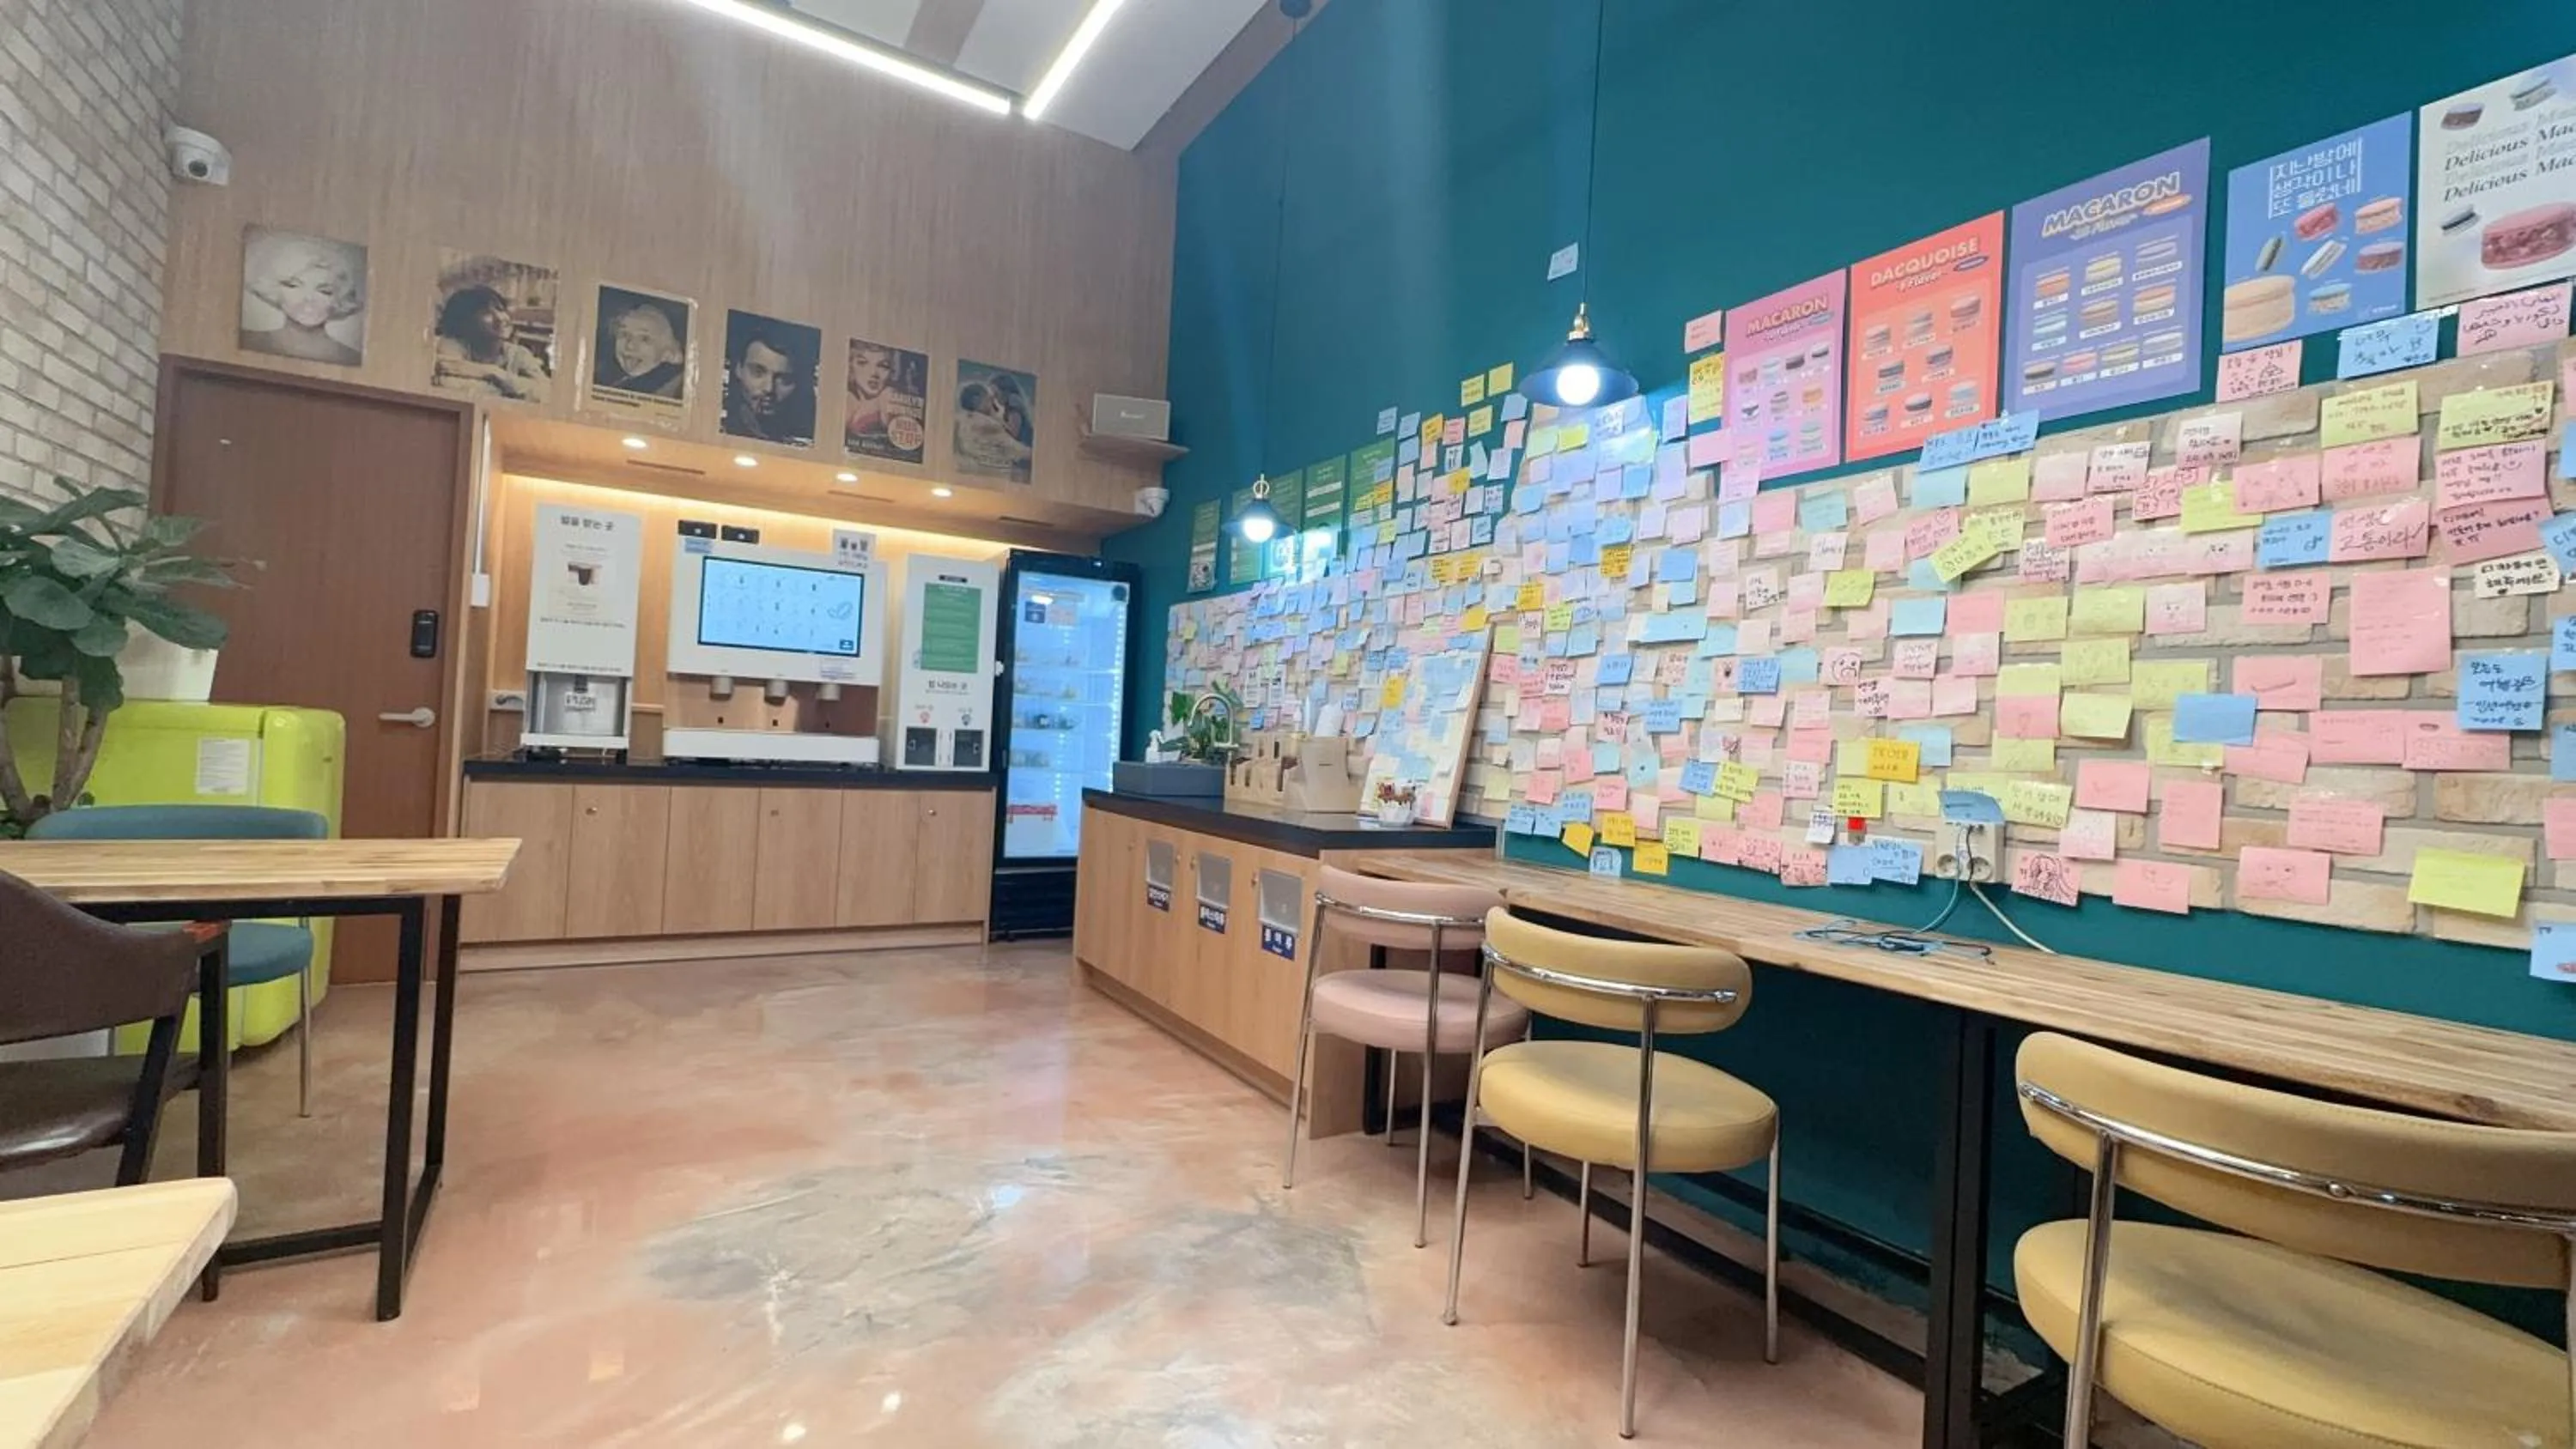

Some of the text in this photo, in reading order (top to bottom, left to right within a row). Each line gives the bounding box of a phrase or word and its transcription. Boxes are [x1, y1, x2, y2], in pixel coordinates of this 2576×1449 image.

[2274, 140, 2356, 182] 지난밤에
[2445, 138, 2528, 171] Delicious
[2273, 159, 2355, 200] 생각이나
[2444, 170, 2528, 203] Delicious
[2041, 171, 2181, 239] MACARON
[2273, 196, 2294, 217] 또
[1870, 236, 1980, 289] DACQUOISE
[1746, 294, 1829, 337] MACARON
